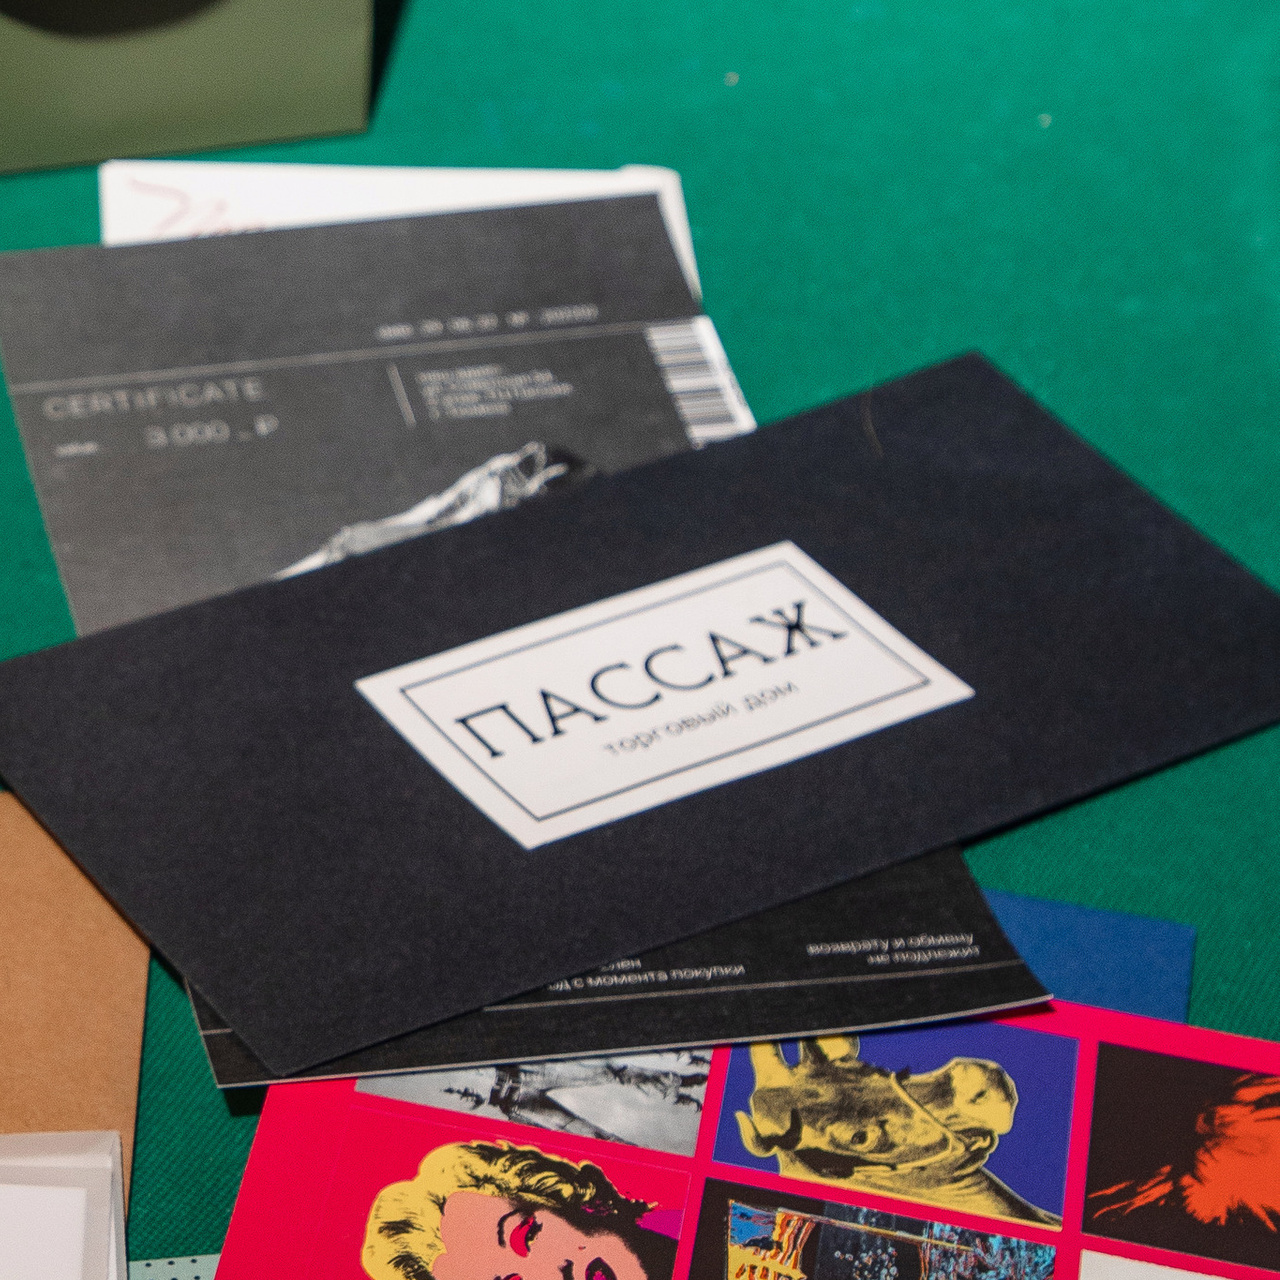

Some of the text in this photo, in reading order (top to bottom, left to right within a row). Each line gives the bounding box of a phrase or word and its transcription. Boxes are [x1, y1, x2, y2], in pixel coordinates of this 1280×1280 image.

[43, 377, 263, 419] CERTIFICATE
[455, 600, 849, 758] ПАССАЖ
[603, 681, 798, 754] торговый дом
[586, 970, 668, 988] момента
